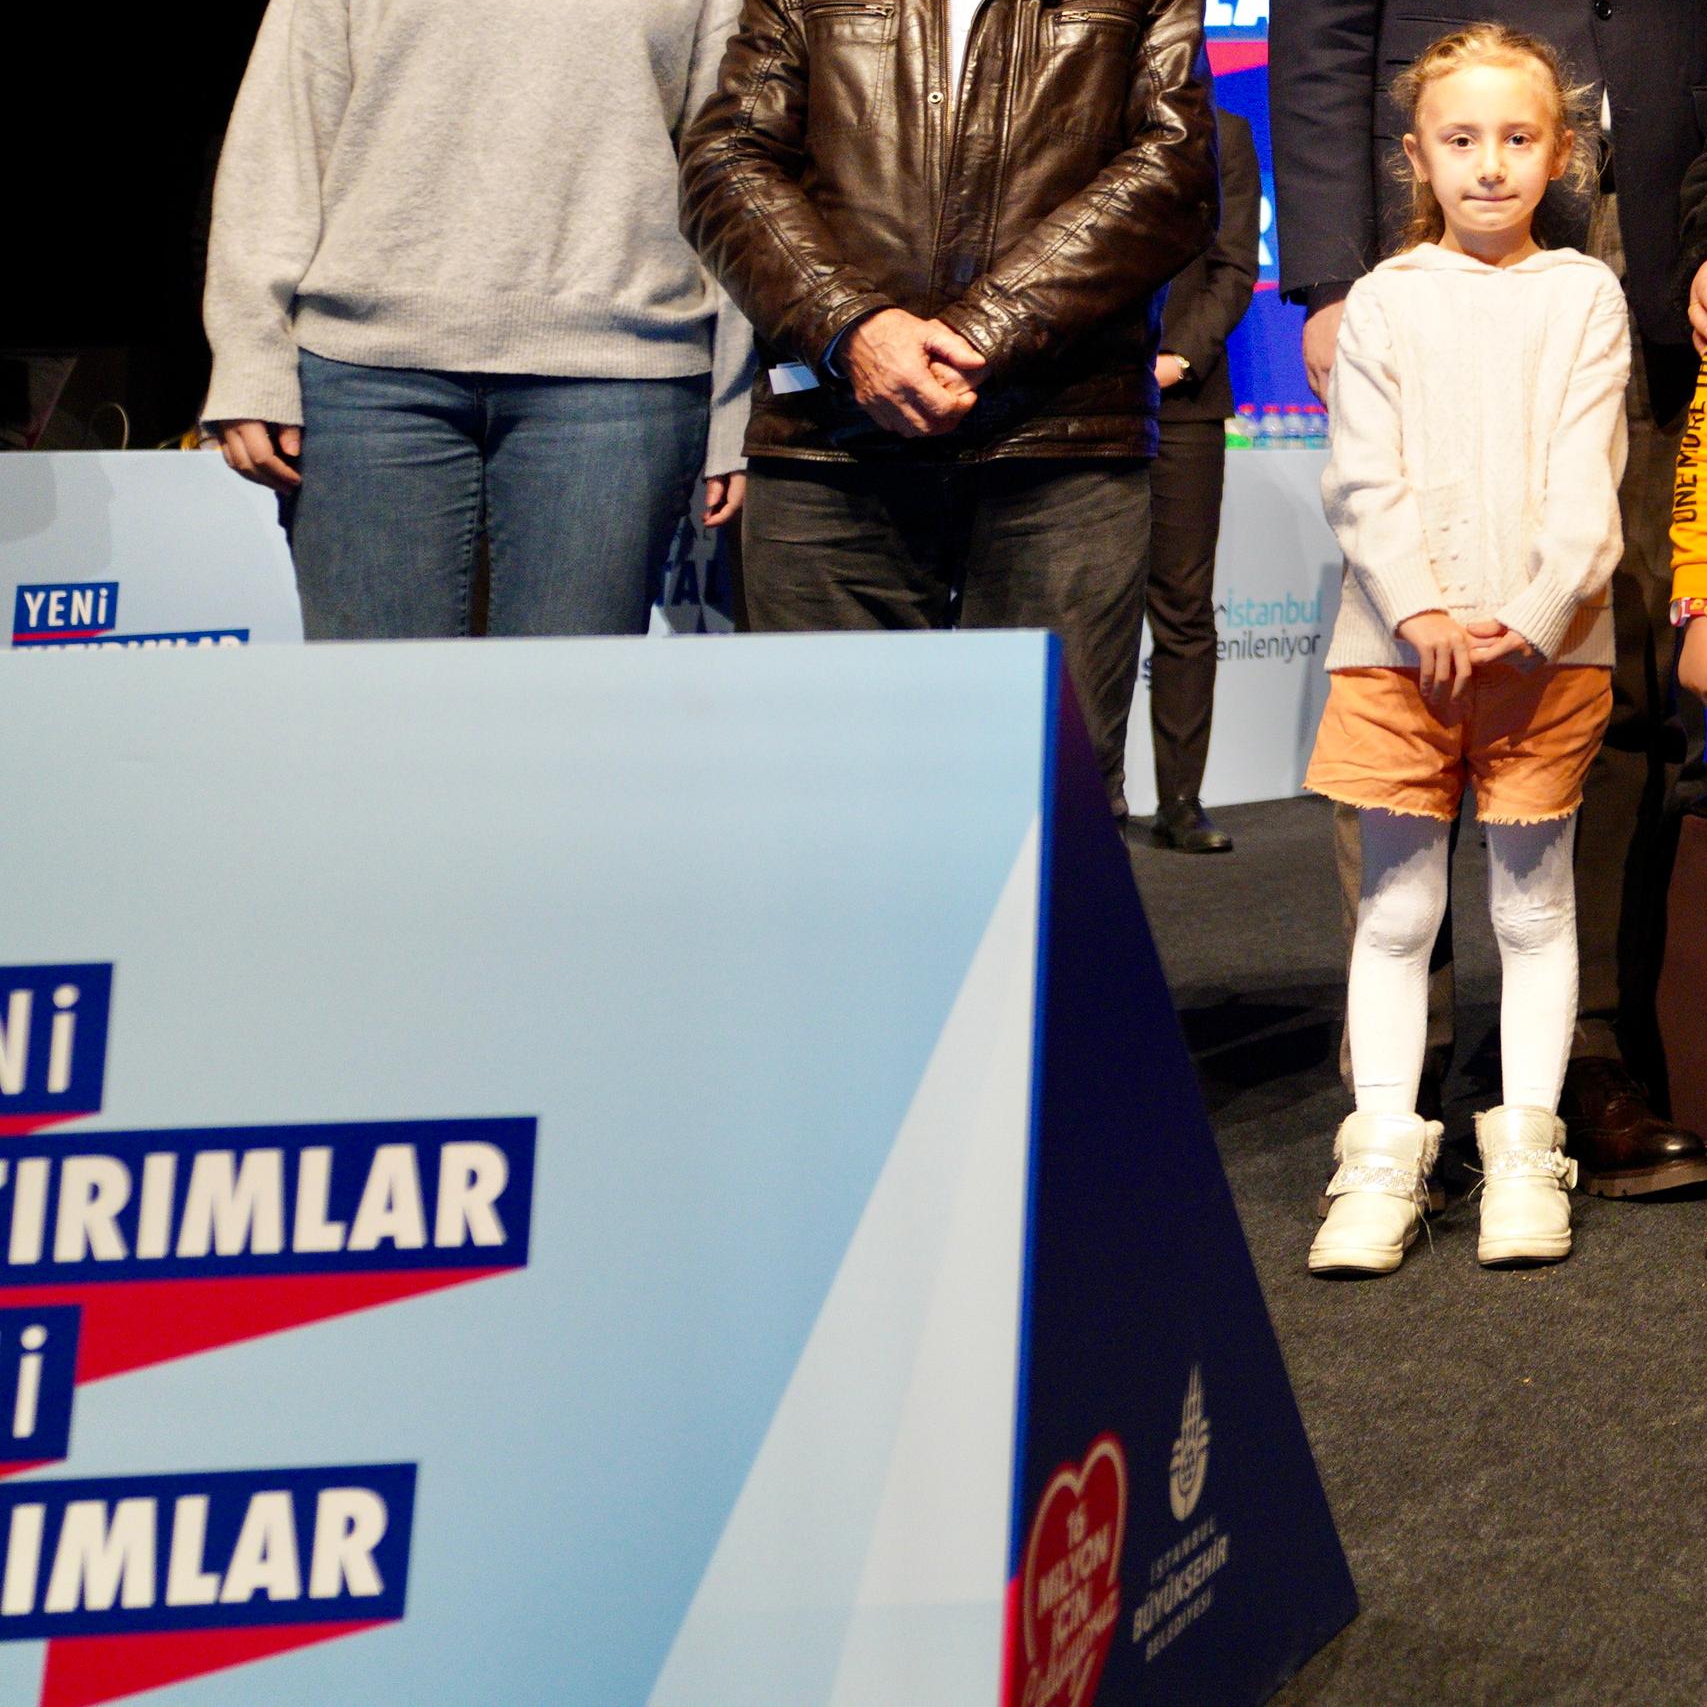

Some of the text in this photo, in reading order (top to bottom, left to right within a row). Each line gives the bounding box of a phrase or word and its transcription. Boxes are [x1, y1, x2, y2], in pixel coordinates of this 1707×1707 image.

[1216, 629, 1321, 664] enileniyor
[0, 1141, 511, 1267] IRIMLAR
[0, 1487, 389, 1618] IMLAR
